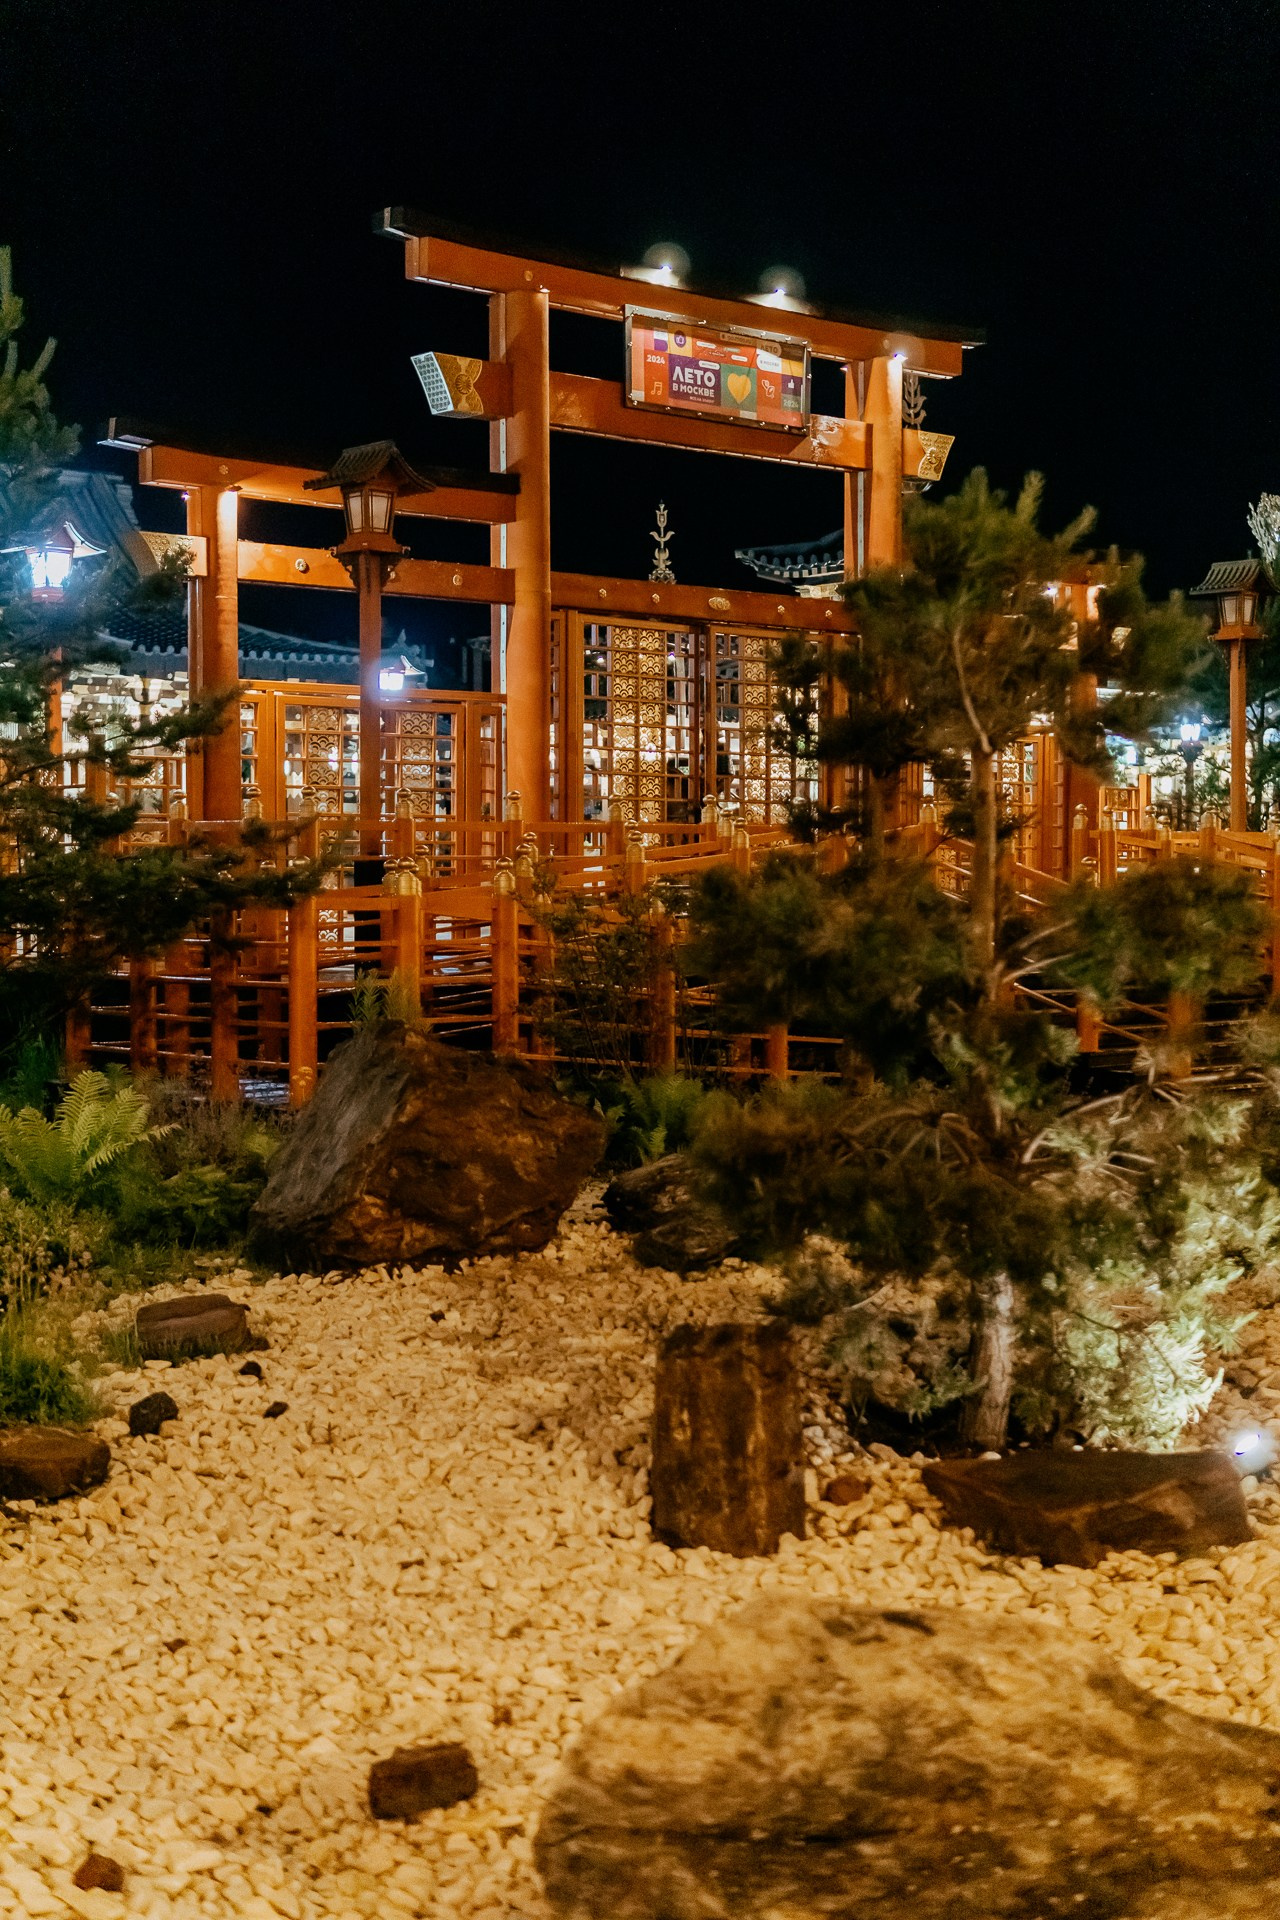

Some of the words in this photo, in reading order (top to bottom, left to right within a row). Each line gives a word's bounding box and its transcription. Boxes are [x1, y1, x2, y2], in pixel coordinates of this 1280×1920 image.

[646, 354, 666, 364] 2024
[672, 366, 716, 387] ЛЕТО
[672, 382, 679, 391] В
[680, 385, 715, 398] МОСКВЕ
[783, 399, 799, 408] 2024
